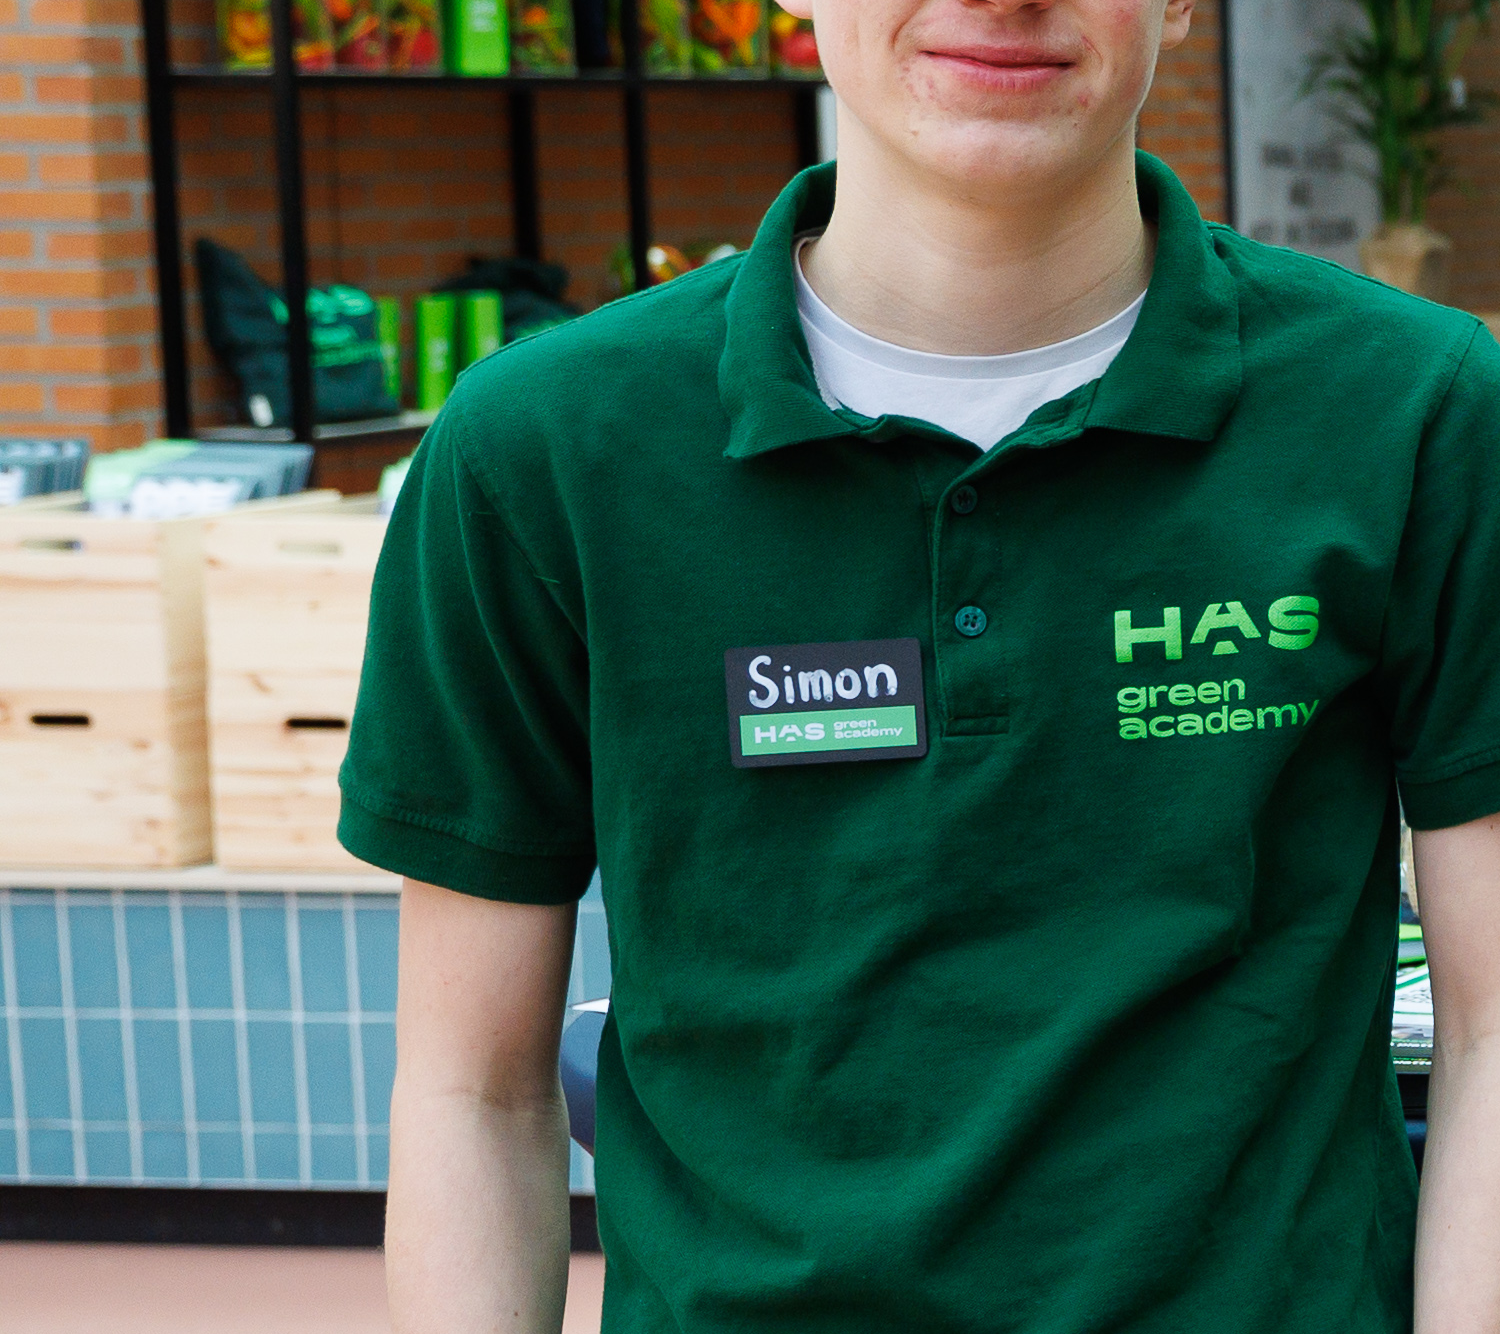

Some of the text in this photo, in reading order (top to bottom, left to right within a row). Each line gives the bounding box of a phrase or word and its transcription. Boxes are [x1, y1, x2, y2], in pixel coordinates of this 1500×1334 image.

[1113, 595, 1320, 664] HAS
[747, 654, 899, 710] Simon
[1117, 677, 1246, 714] green
[753, 717, 877, 745] HAS green
[834, 725, 904, 741] academy
[1118, 698, 1319, 741] academy
